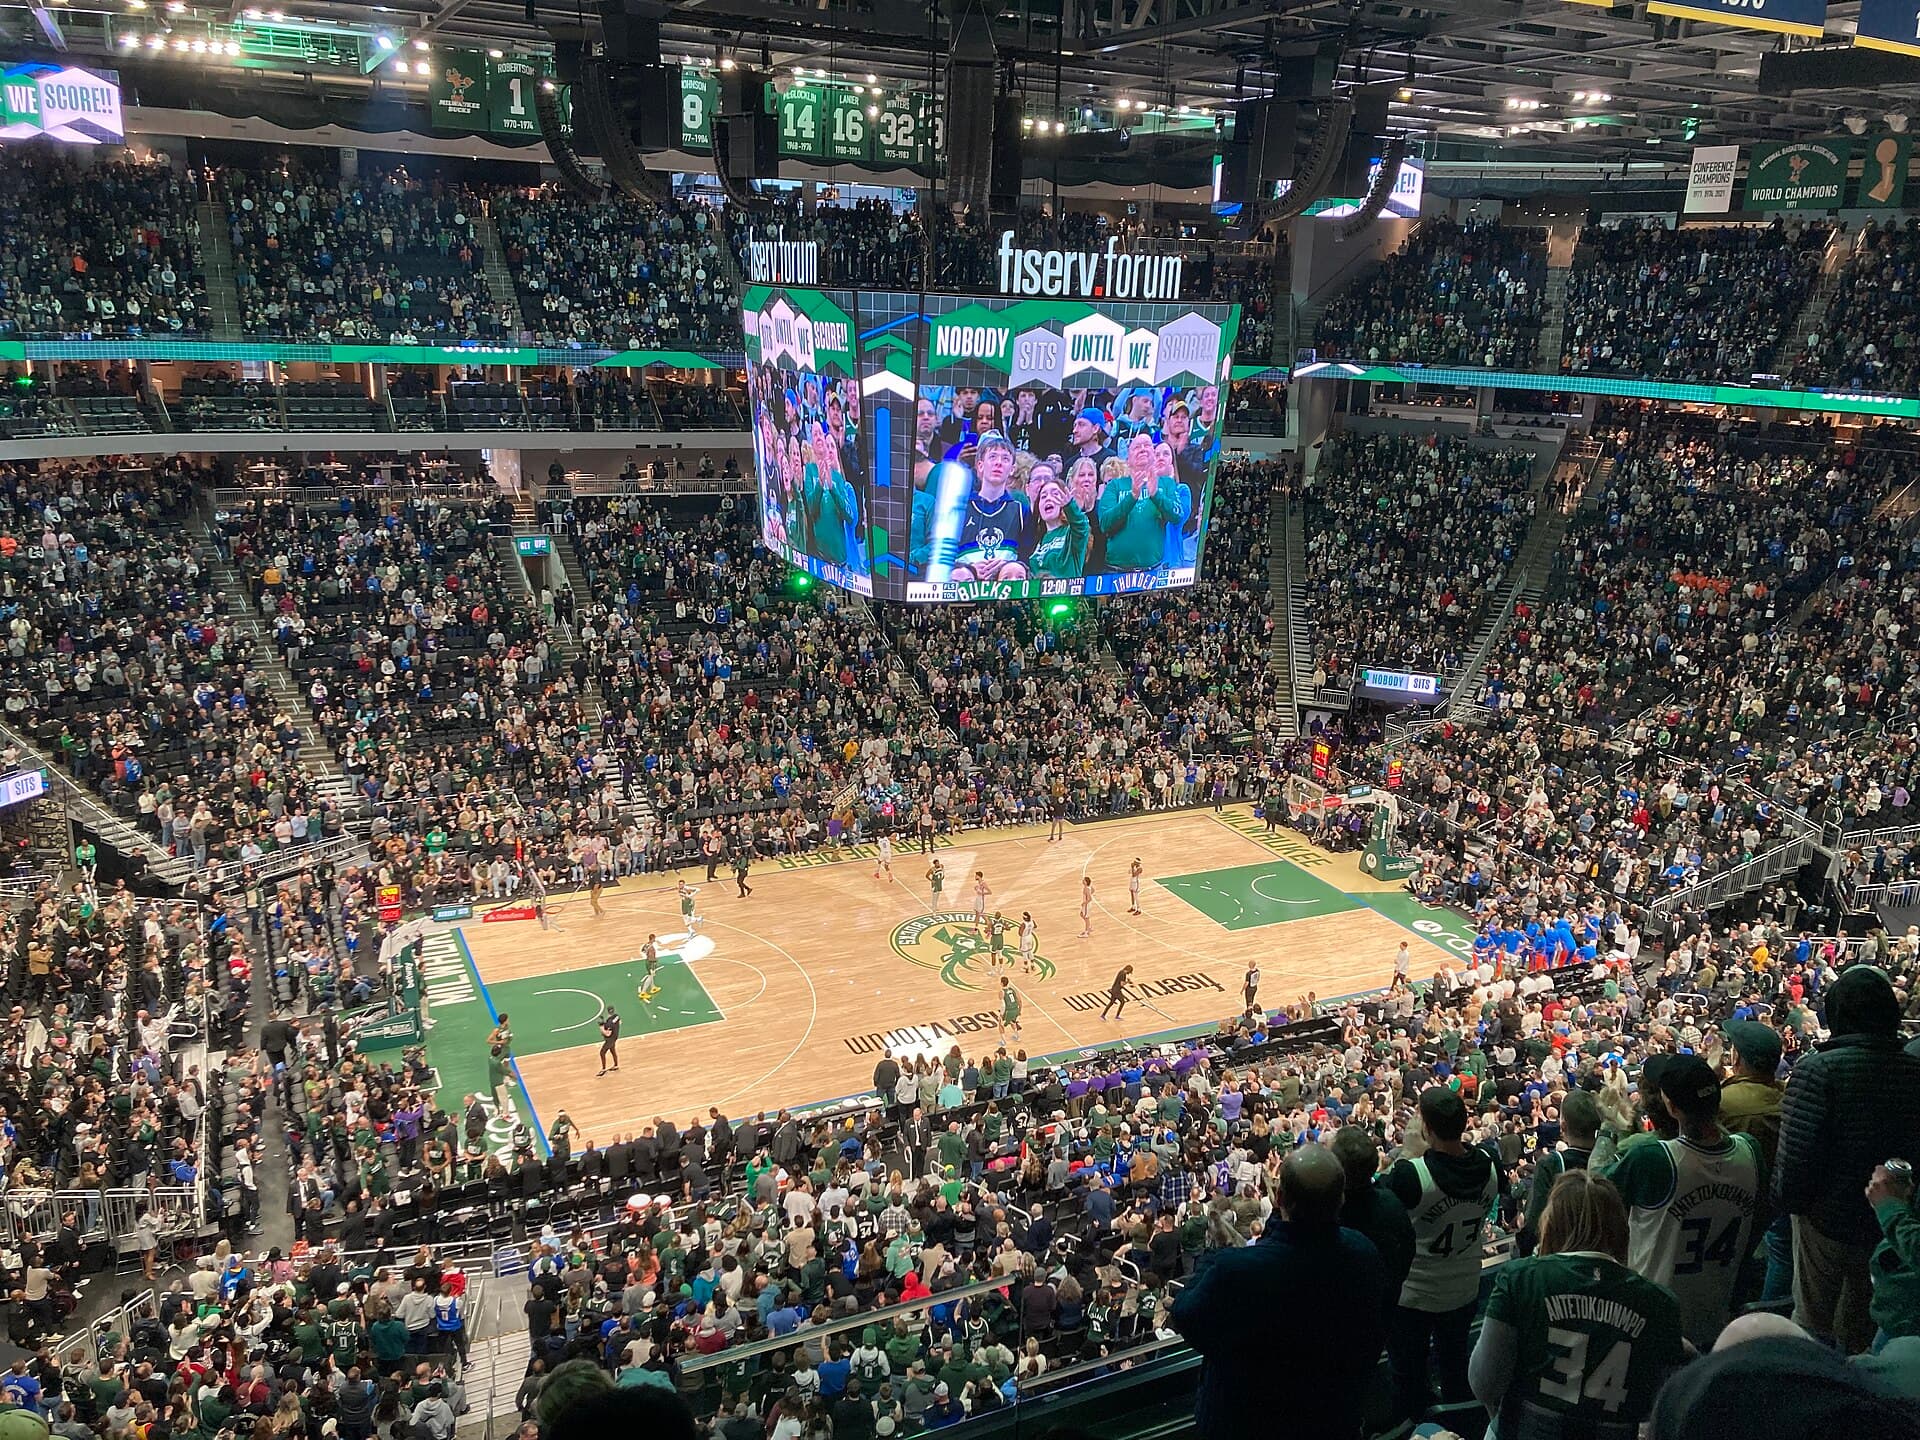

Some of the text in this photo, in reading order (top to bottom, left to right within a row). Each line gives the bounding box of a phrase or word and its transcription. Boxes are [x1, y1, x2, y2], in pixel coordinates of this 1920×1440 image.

[509, 78, 525, 115] 1
[681, 79, 707, 93] OHNSON
[7, 83, 113, 114] WE SCORE!!
[839, 94, 859, 106] LANIER
[886, 98, 910, 111] WINTERS
[683, 94, 703, 129] 8
[783, 103, 815, 139] 14
[833, 107, 864, 142] 16
[880, 112, 915, 147] 32
[1693, 161, 1735, 173] CONFERENCE
[1693, 173, 1731, 184] CHAMPIONS
[1752, 185, 1839, 201] WORLD CHAMPIONS
[1786, 201, 1798, 209] 1971
[798, 327, 811, 356] WE
[814, 321, 848, 352] SCORE!!
[936, 324, 1216, 371] NOBODY SITS UNTIL WE SCORE!!
[957, 577, 1085, 600] BUCKS 0 12:00 INTR
[1096, 575, 1102, 592] 0
[1112, 571, 1157, 593] THUNDER
[943, 591, 955, 599] TOL
[1372, 674, 1430, 690] NOBODY SITS
[14, 776, 36, 796] SITS
[1062, 972, 1226, 1012] fiserv.frum
[860, 1227, 872, 1239] 34
[1675, 1216, 1742, 1275] 34
[1544, 1293, 1647, 1339] ANTETOKOUNMPO
[1539, 1326, 1632, 1413] 34
